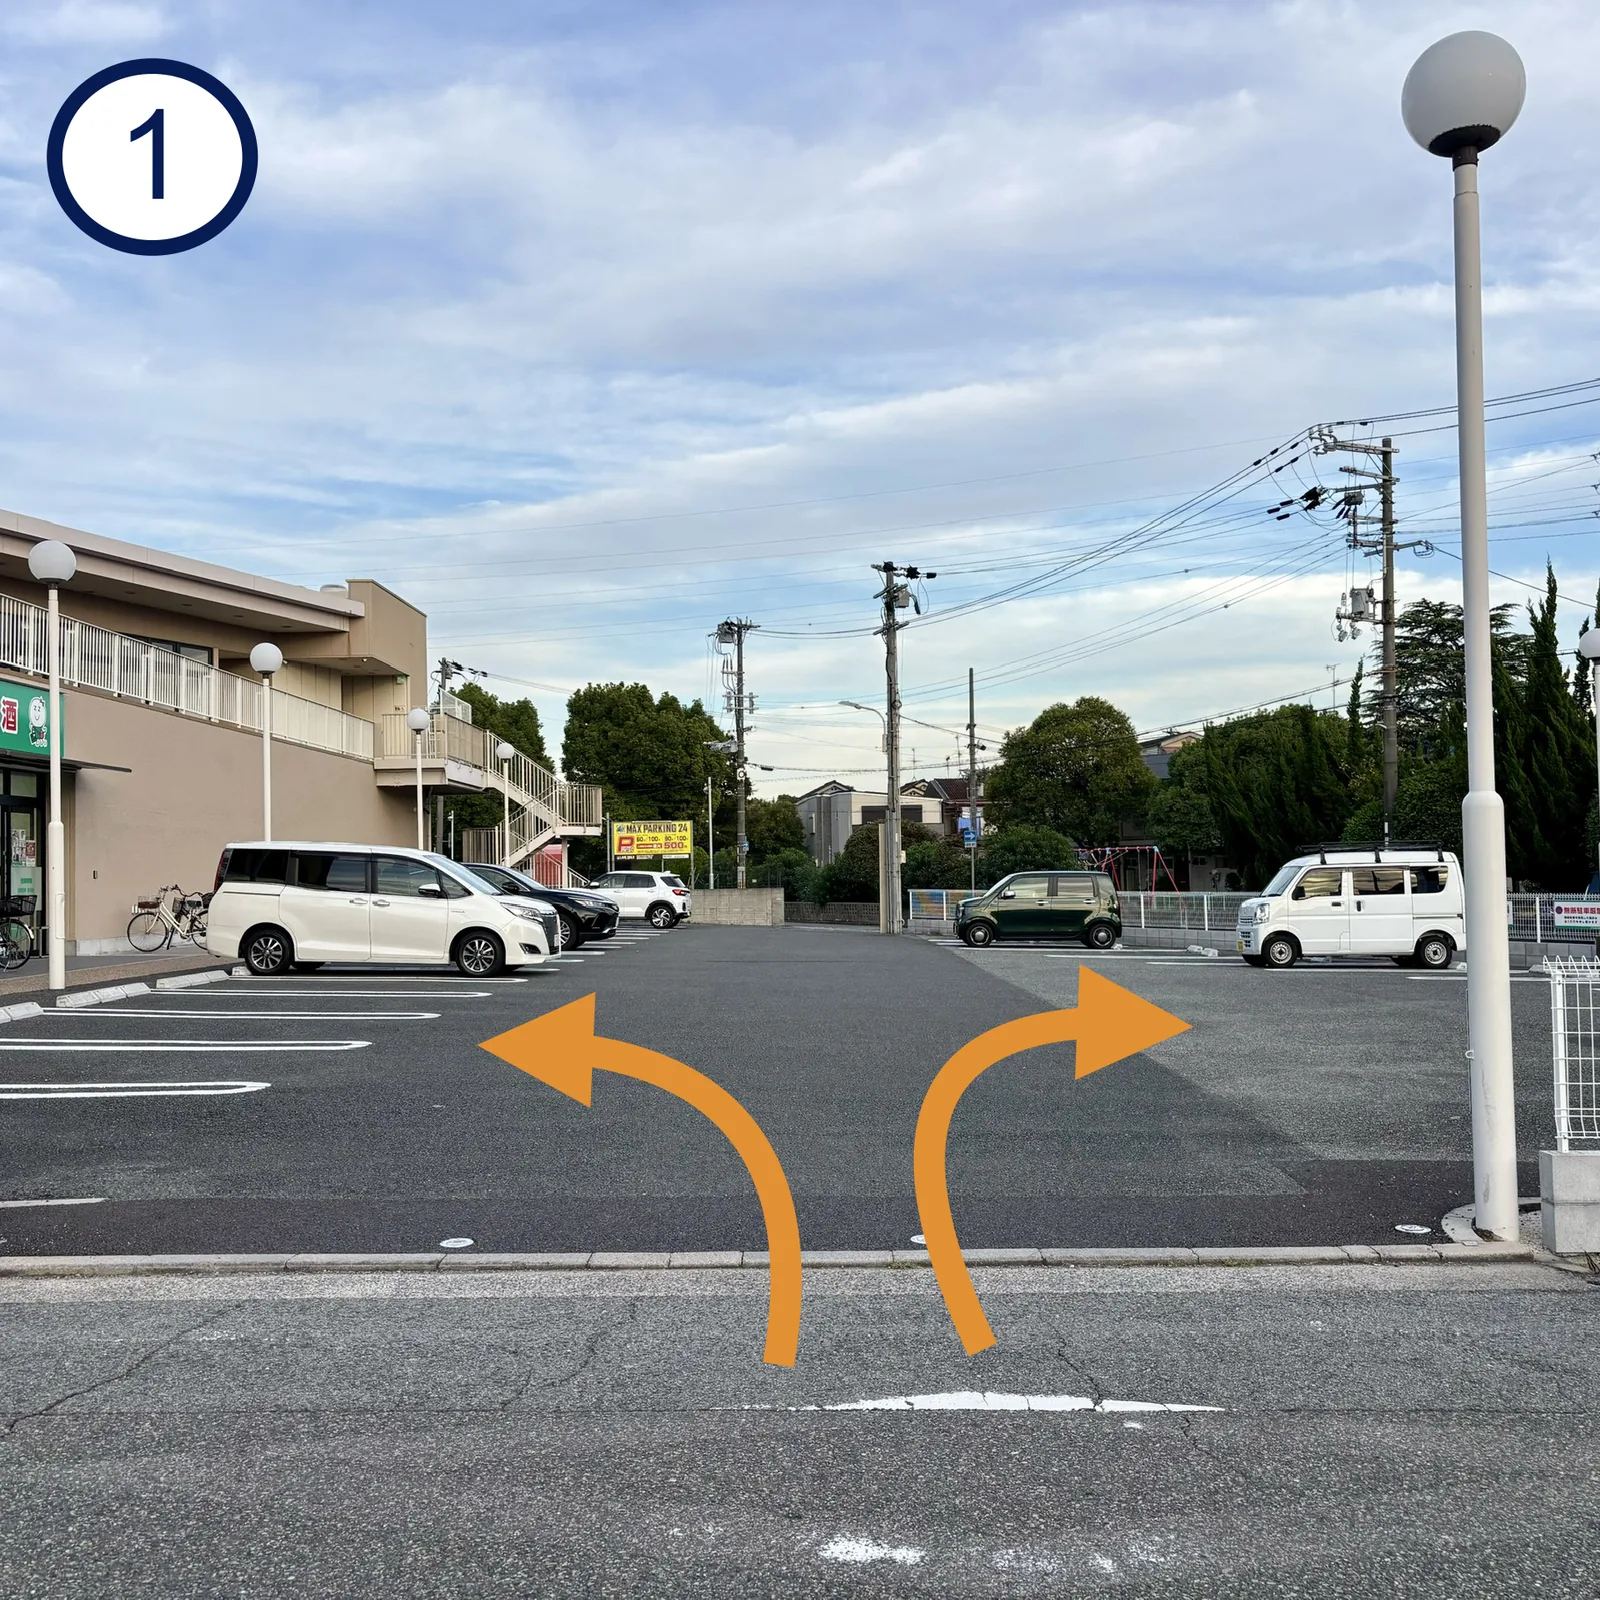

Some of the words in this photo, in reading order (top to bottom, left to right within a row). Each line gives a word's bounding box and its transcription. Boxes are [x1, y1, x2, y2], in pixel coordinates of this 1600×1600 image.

[1, 697, 18, 733] 酒
[626, 824, 642, 834] MAX
[643, 823, 677, 833] PARKING
[678, 823, 688, 832] 24
[617, 836, 635, 853] P
